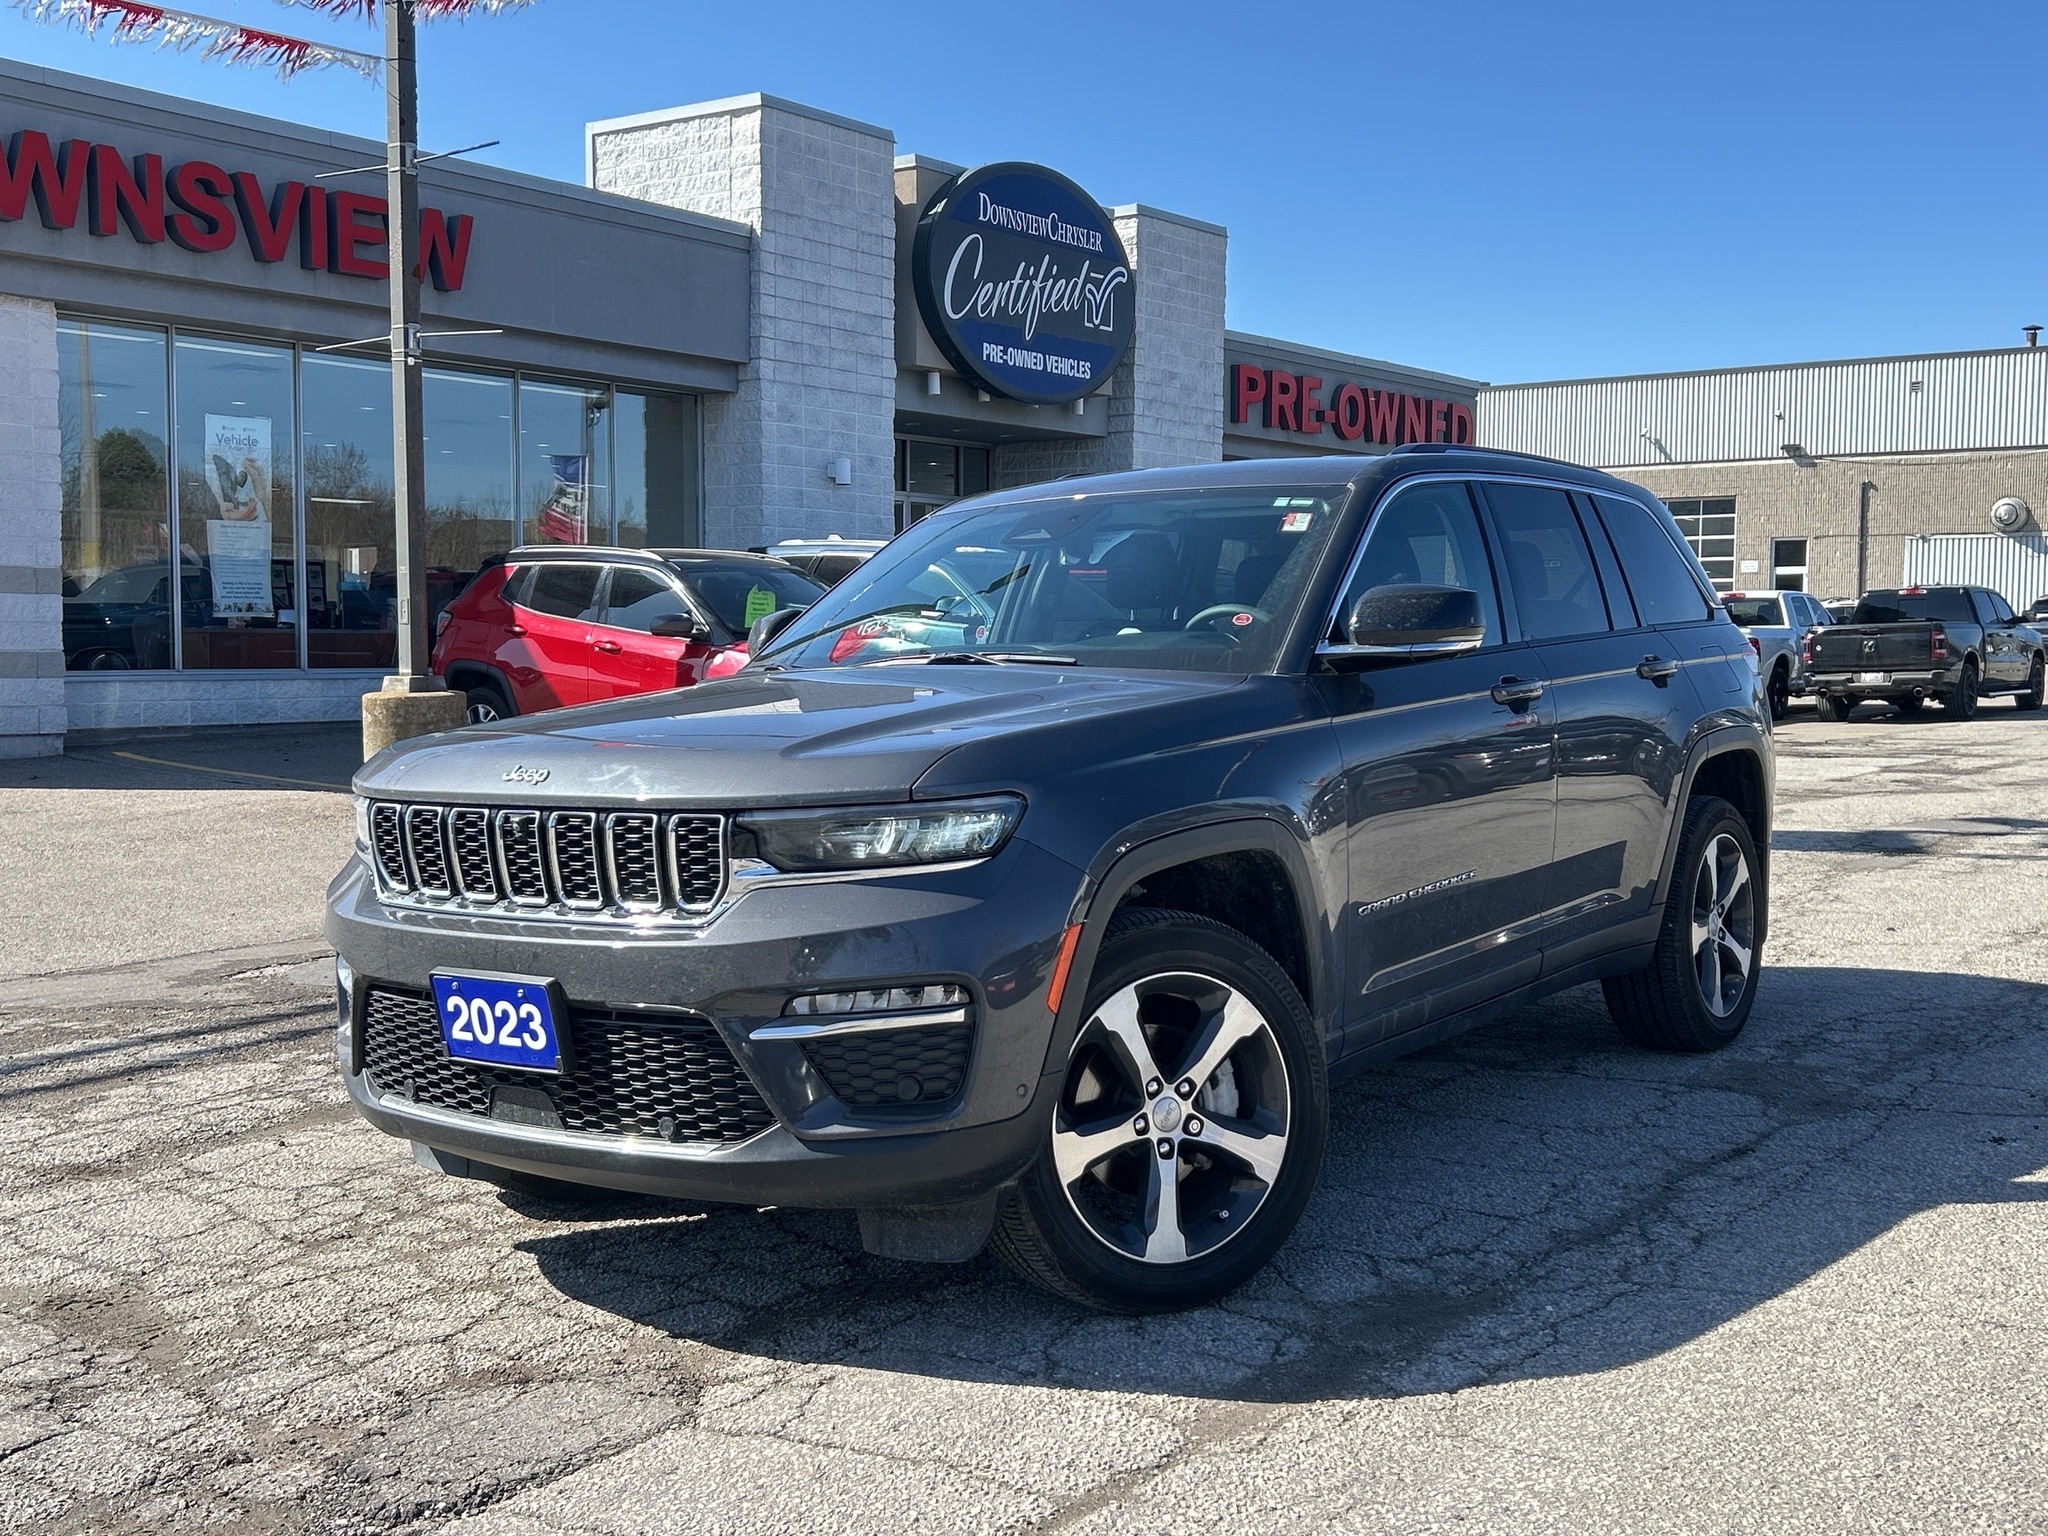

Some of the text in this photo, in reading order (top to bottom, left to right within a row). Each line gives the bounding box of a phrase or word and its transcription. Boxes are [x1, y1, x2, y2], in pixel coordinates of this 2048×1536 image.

[944, 233, 1090, 341] Certified
[983, 342, 1091, 380] PRE-OWNED VEHICLES
[1231, 364, 1473, 445] PRE-OWNED
[216, 433, 259, 447] Vehicle
[502, 764, 550, 785] Jeep
[1357, 869, 1478, 916] GRAND CHEROKEE
[447, 995, 547, 1051] 2023
